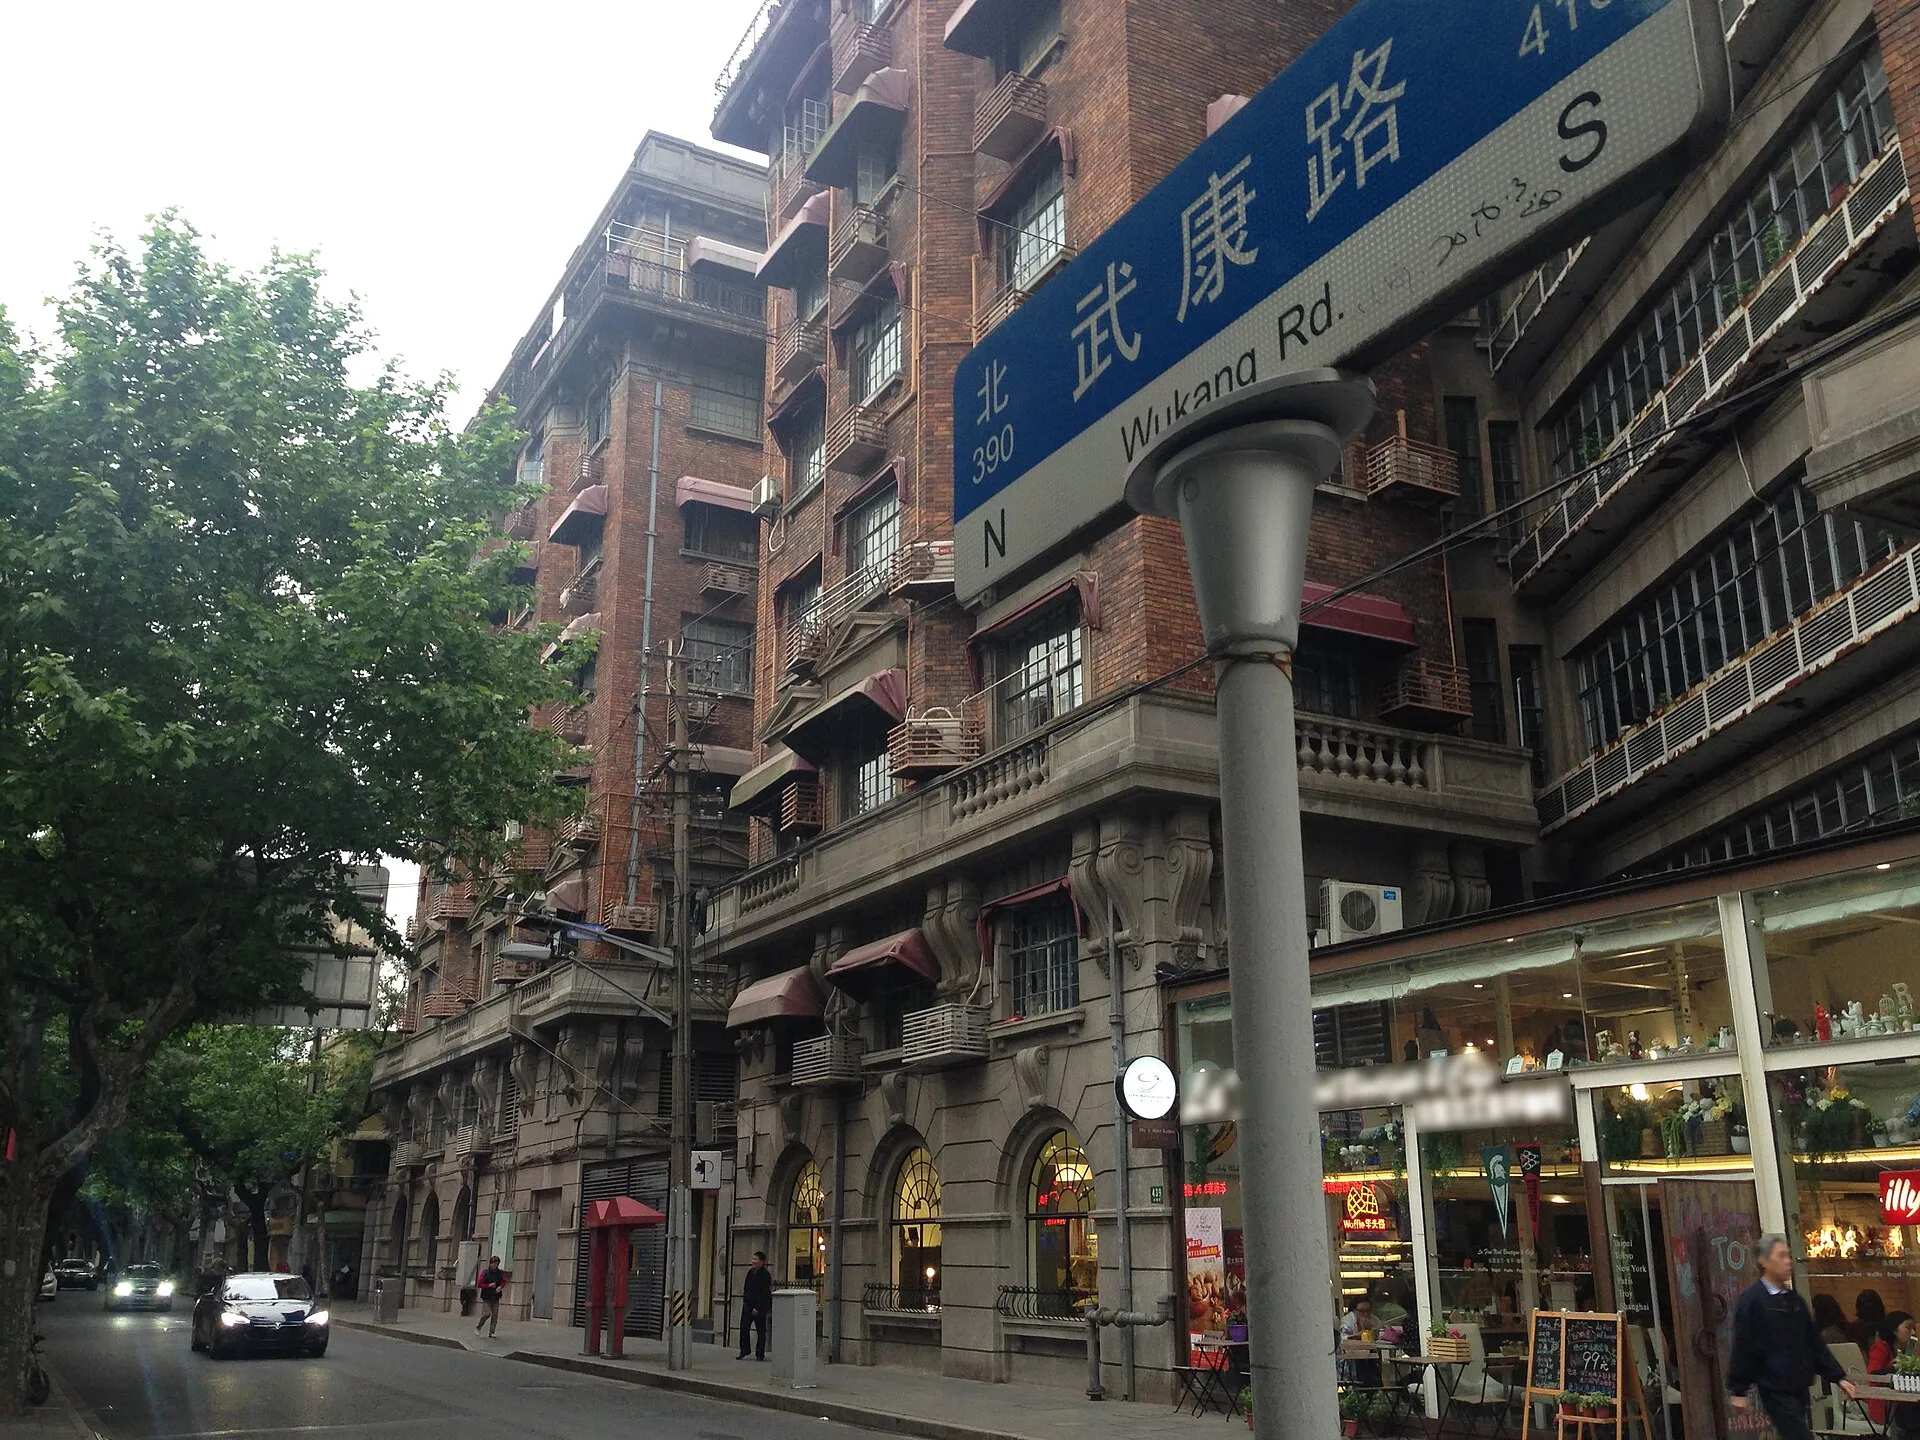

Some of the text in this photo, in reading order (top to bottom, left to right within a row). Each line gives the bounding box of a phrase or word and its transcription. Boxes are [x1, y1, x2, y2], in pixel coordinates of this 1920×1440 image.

[1518, 0, 1611, 57] 41
[1557, 91, 1607, 172] S
[1071, 37, 1407, 402] 武康路
[1278, 281, 1344, 361] Rd.
[976, 358, 1009, 425] 北
[972, 423, 1014, 485] 390
[984, 507, 1006, 568] N
[1884, 1177, 1920, 1218] illy
[1631, 1264, 1647, 1272] York
[1711, 1235, 1745, 1270] TO
[1620, 1302, 1650, 1312] Shanghai
[1582, 1351, 1600, 1371] 99
